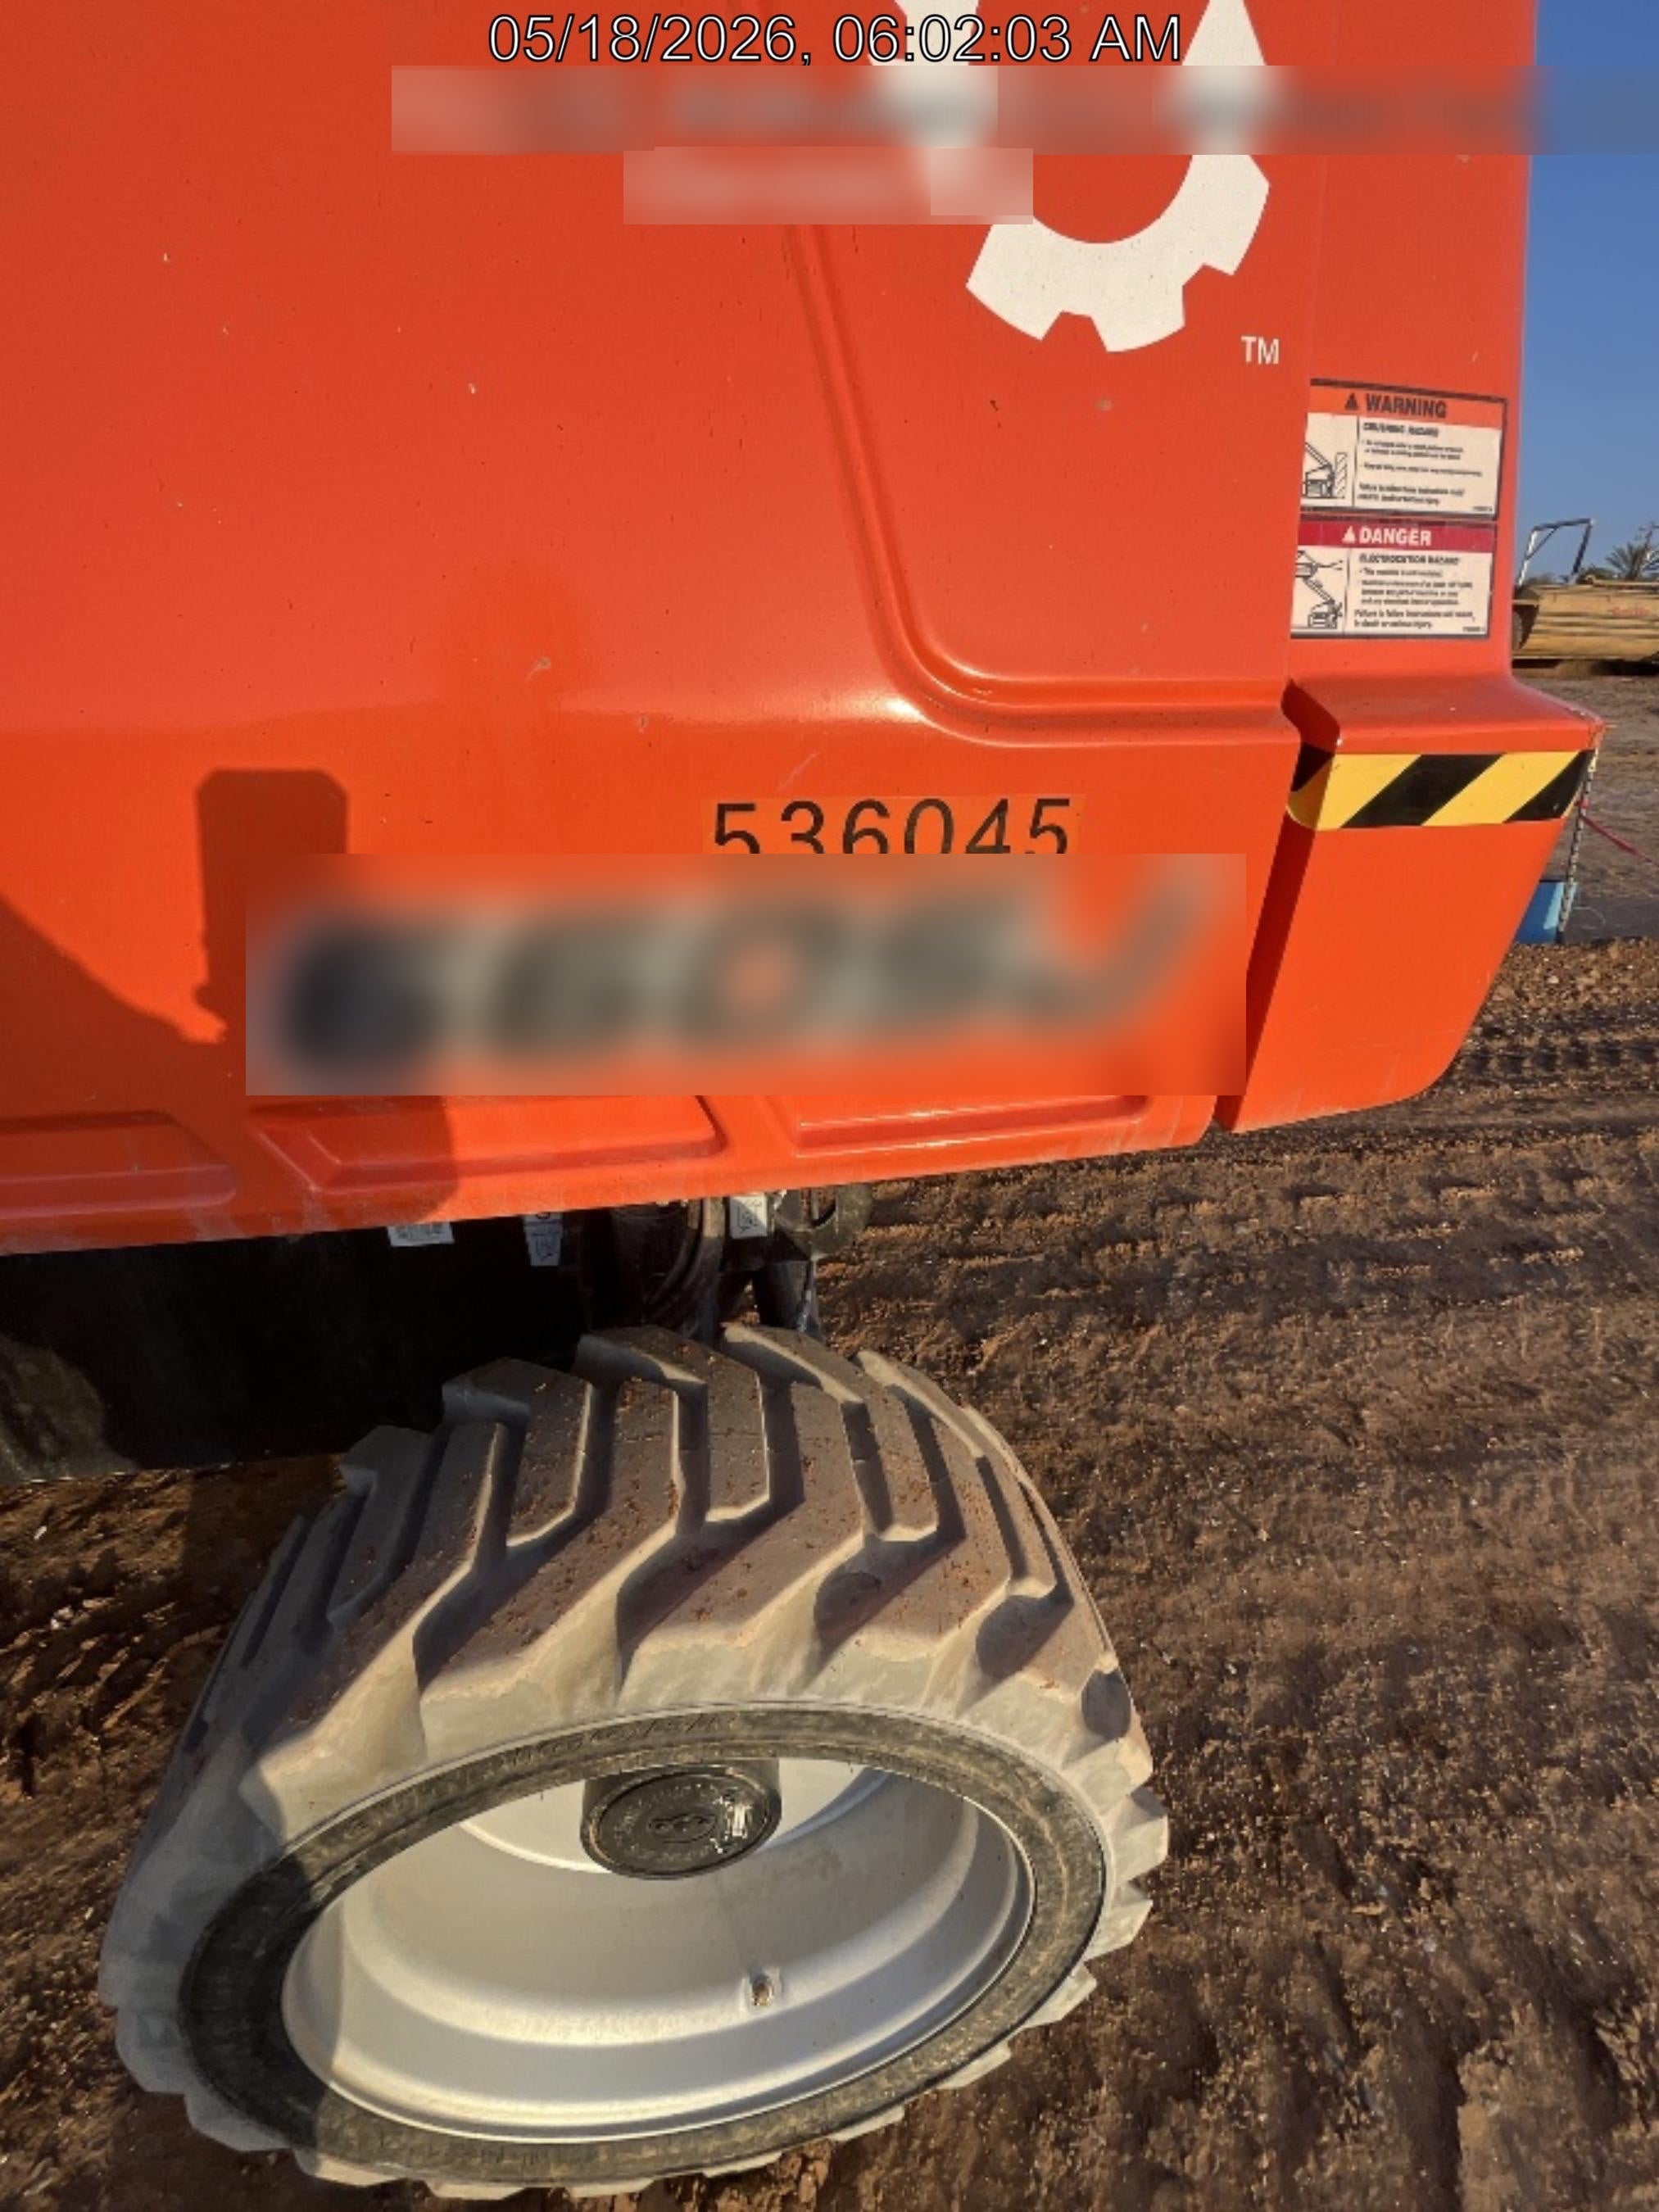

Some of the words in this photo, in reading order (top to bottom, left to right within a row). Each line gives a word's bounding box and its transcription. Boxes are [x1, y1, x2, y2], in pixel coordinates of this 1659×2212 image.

[1240, 335, 1280, 365] TM
[1366, 393, 1447, 418] WARNING
[1359, 526, 1432, 546] DANGER
[714, 798, 1070, 854] 536045
